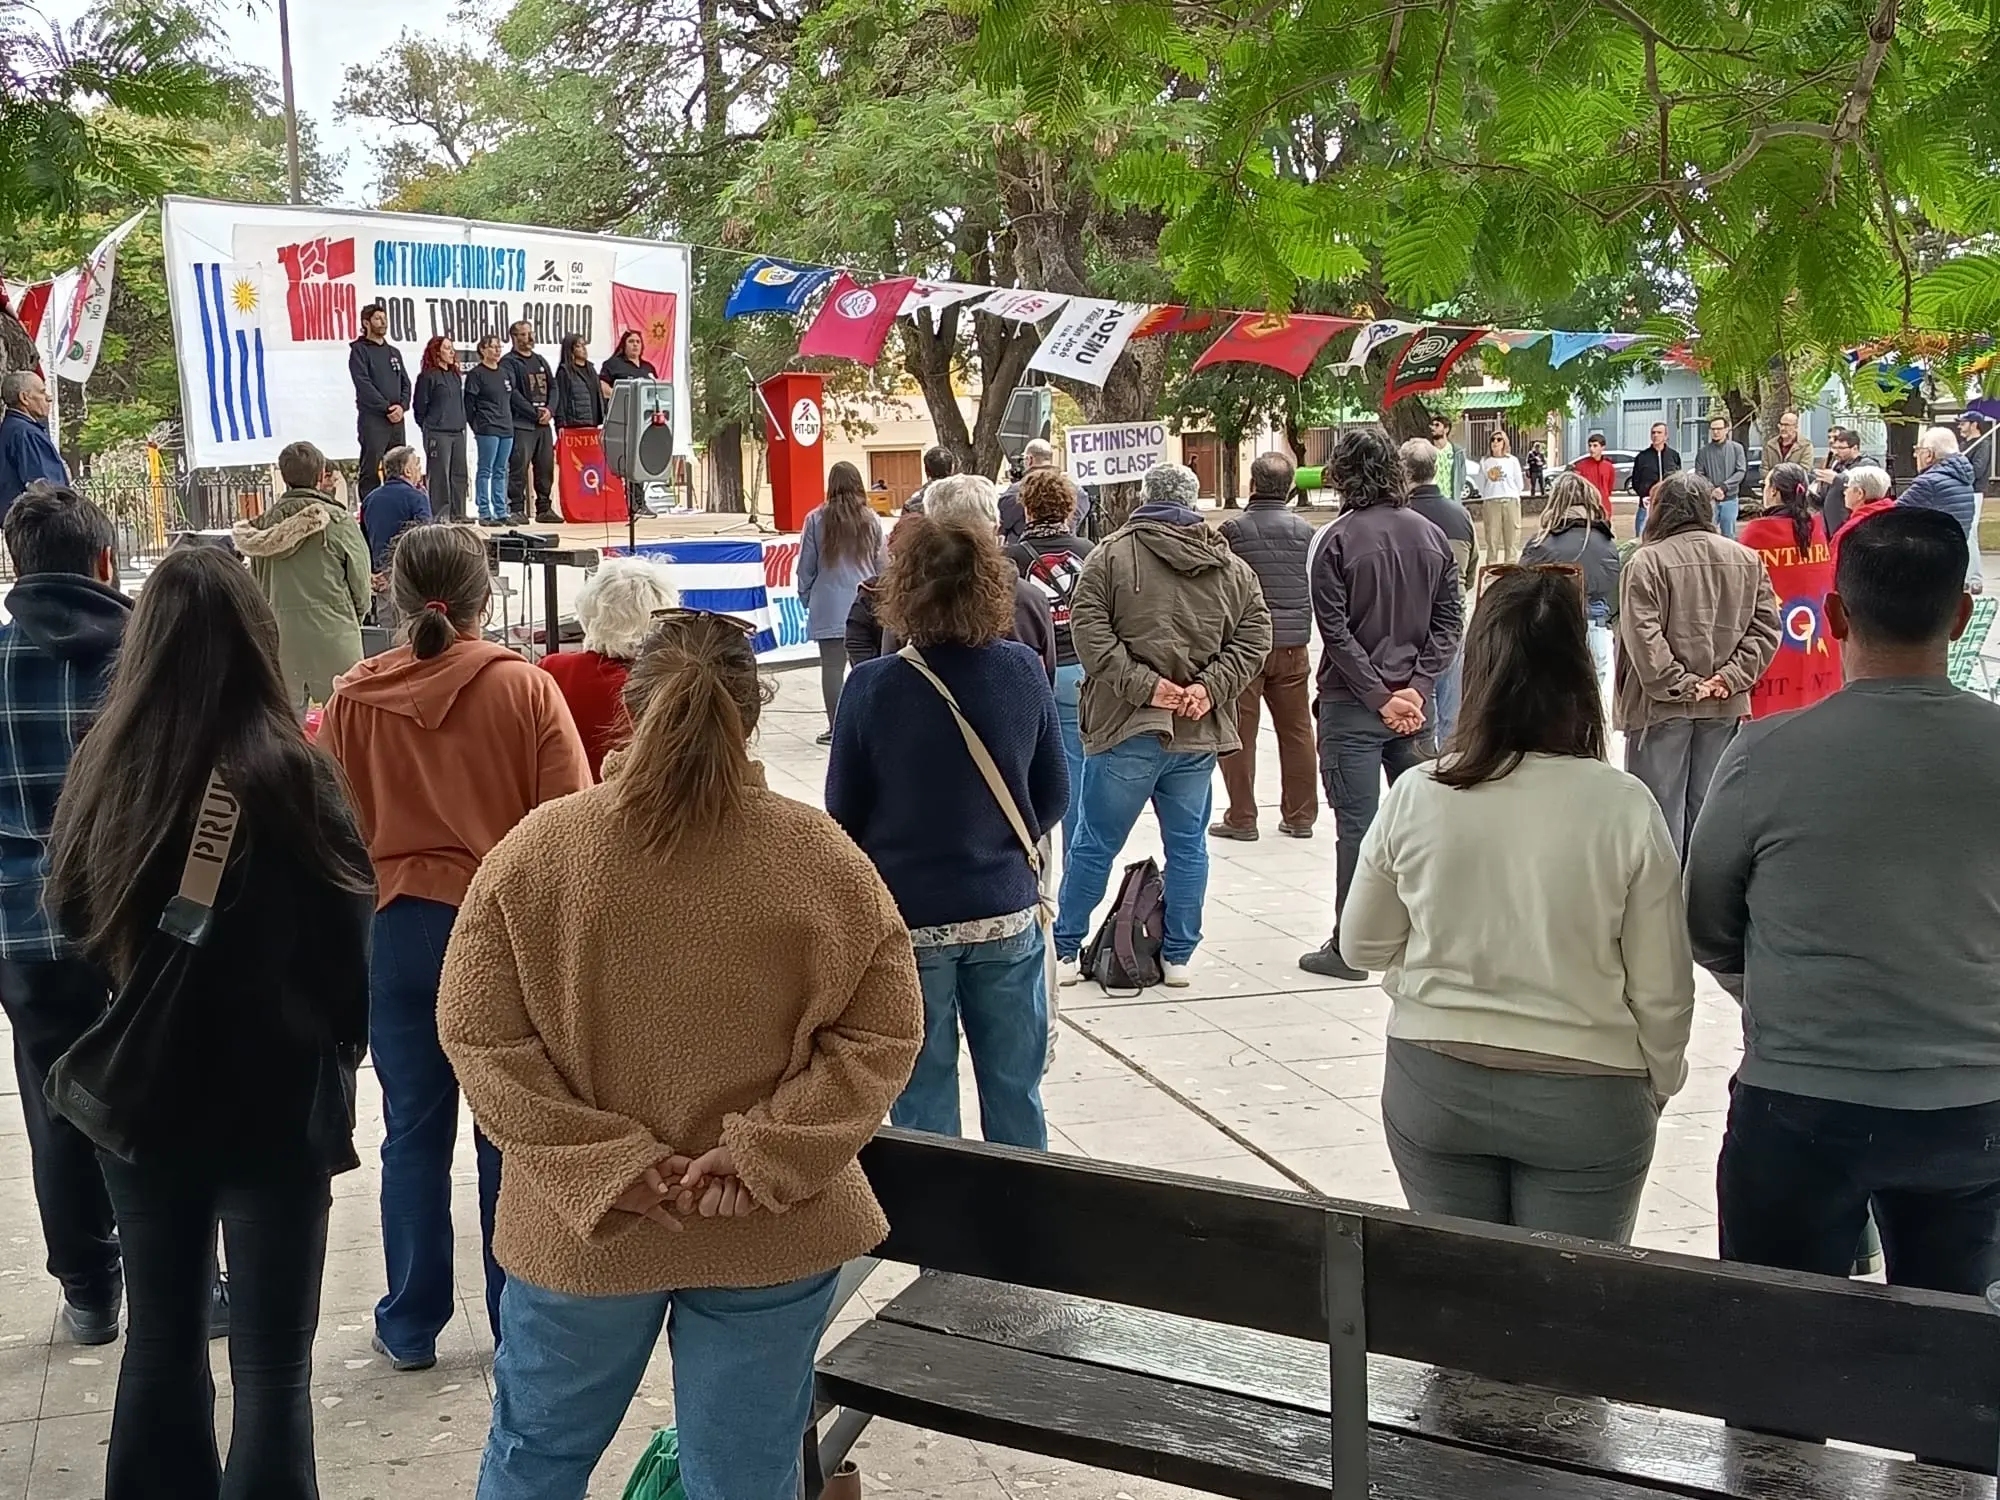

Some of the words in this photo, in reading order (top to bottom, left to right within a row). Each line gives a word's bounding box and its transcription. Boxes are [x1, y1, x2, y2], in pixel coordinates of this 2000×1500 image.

[571, 262, 583, 274] 60
[302, 282, 358, 341] MAYO
[375, 296, 417, 342] OR
[1084, 307, 1105, 325] Filial
[1074, 324, 1091, 339] San
[1075, 308, 1125, 367] ADEMU
[565, 435, 600, 448] UNTM
[1070, 425, 1164, 454] FEMINISMO
[1076, 460, 1098, 478] DE
[1104, 452, 1158, 475] CLASE
